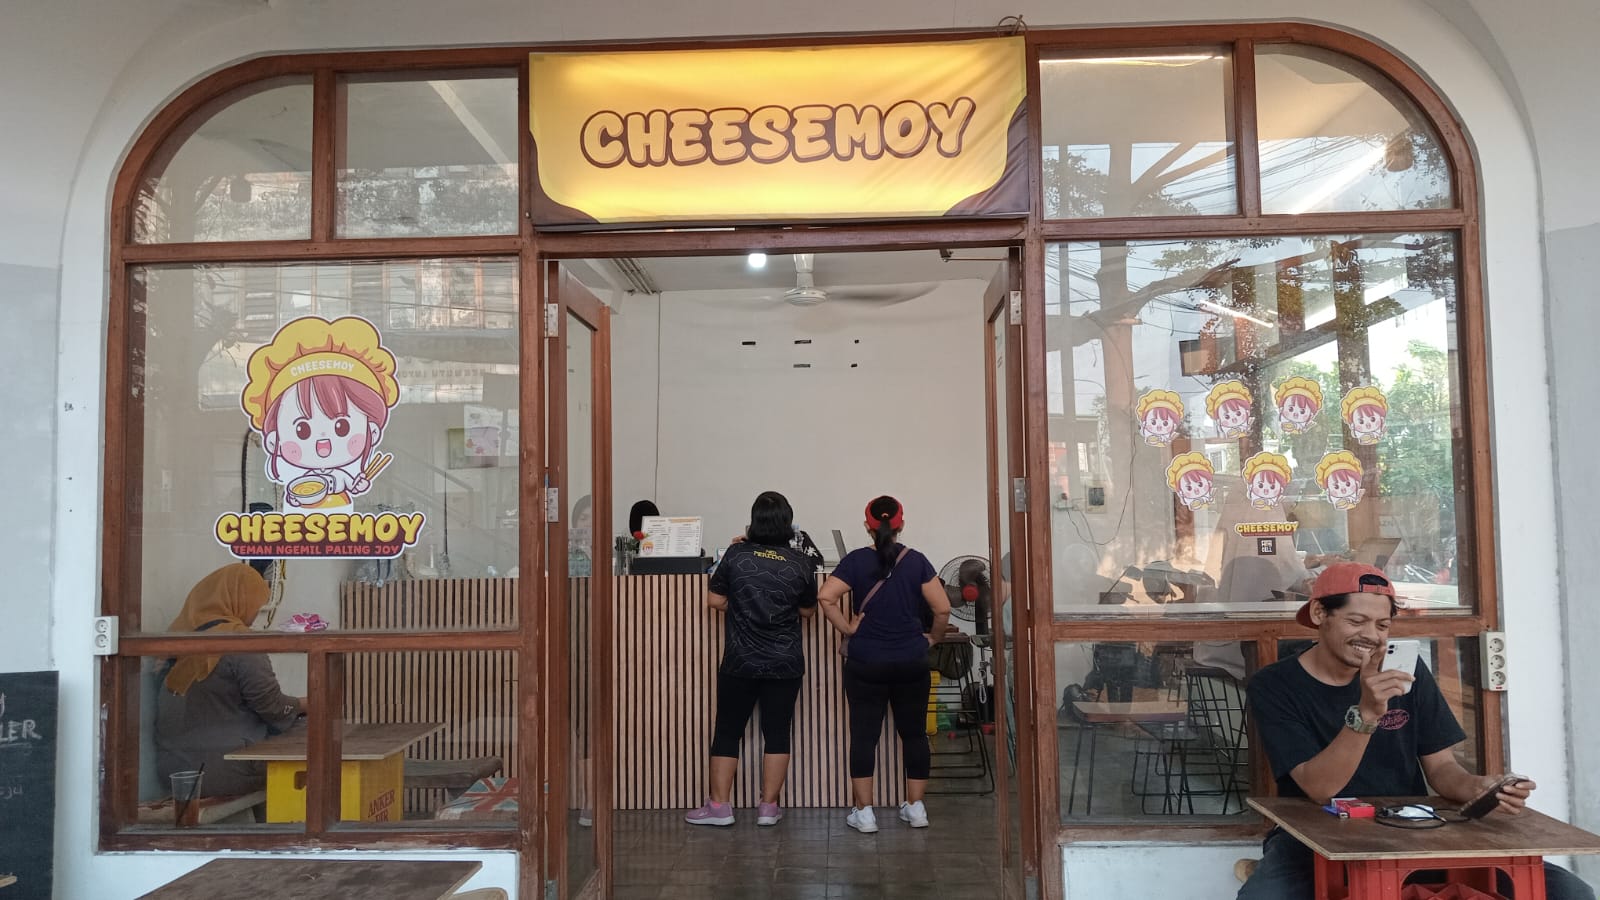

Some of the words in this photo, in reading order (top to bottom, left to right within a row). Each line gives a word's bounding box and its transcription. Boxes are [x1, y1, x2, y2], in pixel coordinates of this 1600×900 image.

[580, 96, 976, 169] CHEESEMOY
[290, 360, 354, 376] CHEESEMOY
[216, 513, 424, 544] CHEESEMOY
[1236, 523, 1298, 534] CHEESEMOY
[233, 545, 272, 554] TEMAN
[276, 545, 321, 554] NGEMIL
[325, 545, 371, 554] PALING
[375, 545, 399, 554] JOY
[367, 789, 395, 818] ANKER
